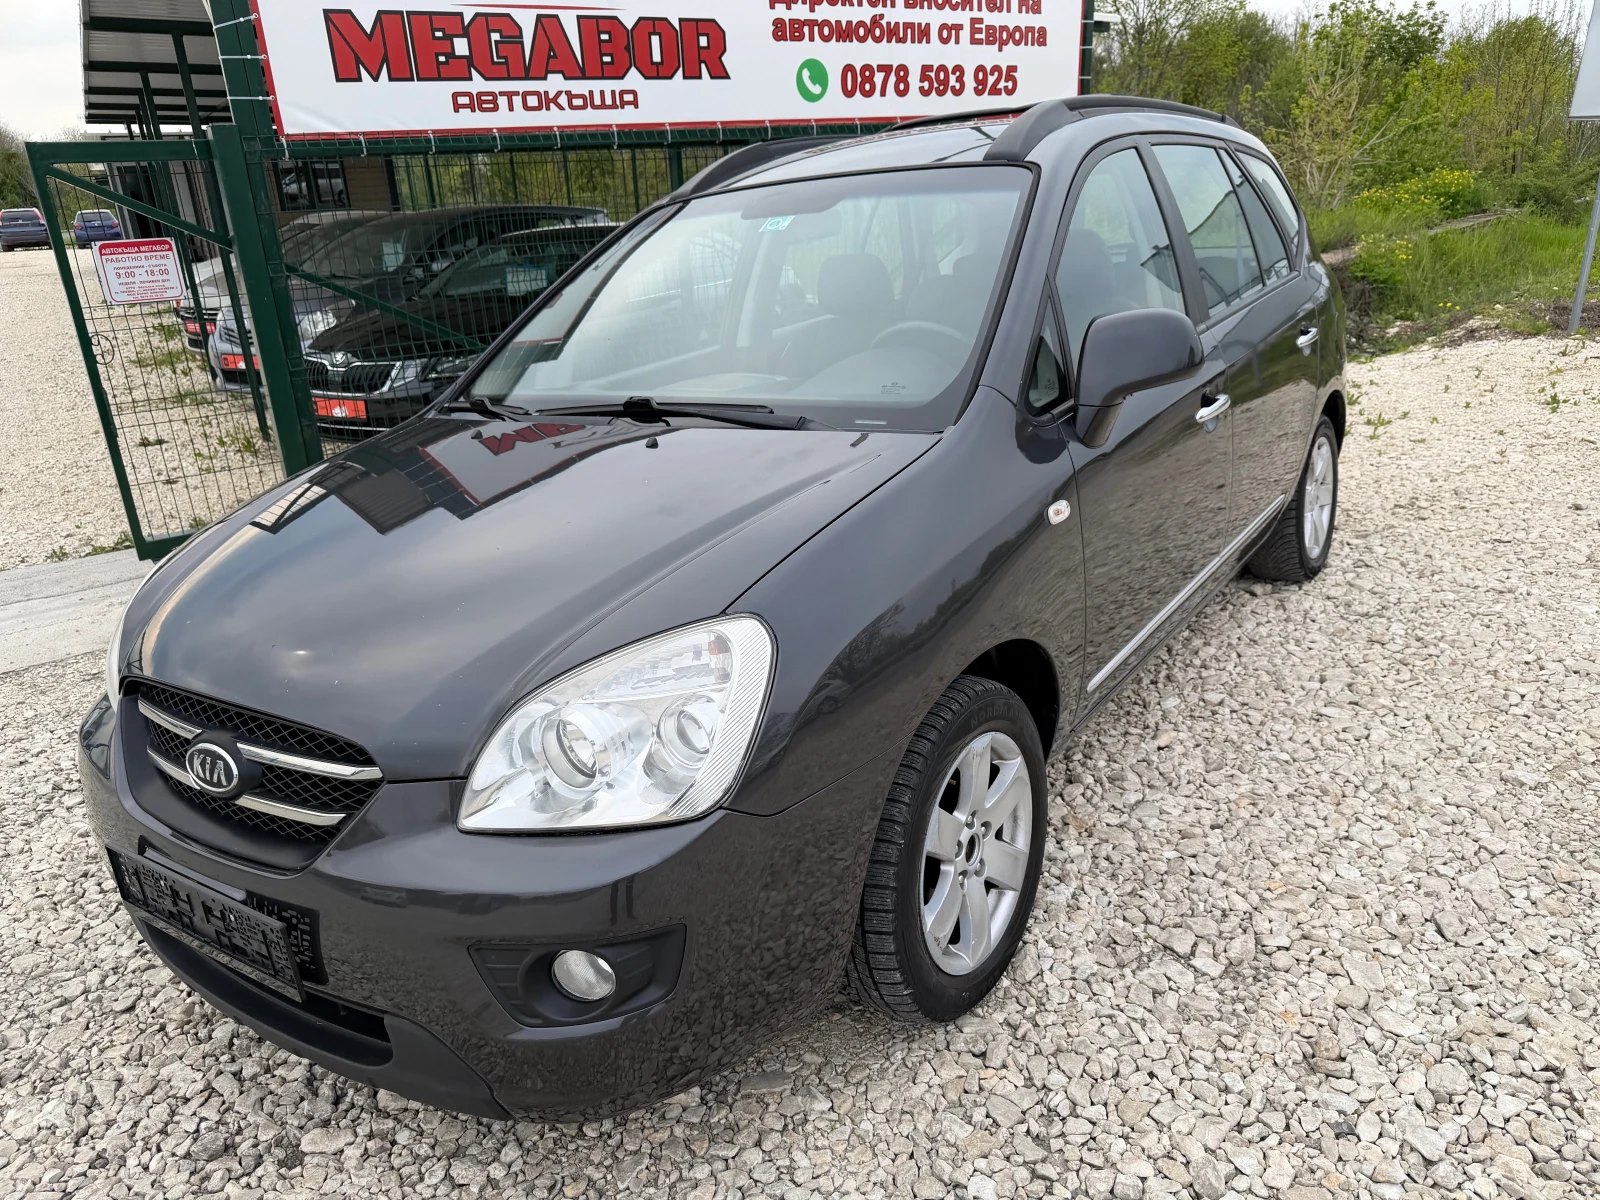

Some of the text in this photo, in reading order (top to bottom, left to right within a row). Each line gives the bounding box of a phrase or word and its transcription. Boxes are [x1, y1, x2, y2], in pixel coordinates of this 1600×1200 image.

[323, 8, 731, 83] MEGABOR
[771, 14, 1048, 52] автомобили от Европа
[840, 64, 1018, 98] 0878 593 925
[101, 244, 170, 254] АВТОКЪЩА МЕГАБОР
[105, 253, 171, 263] РАБОТНО ВРЕМЕ
[115, 270, 136, 279] 9:00
[145, 268, 170, 277] 18:00
[193, 751, 228, 786] KIA
